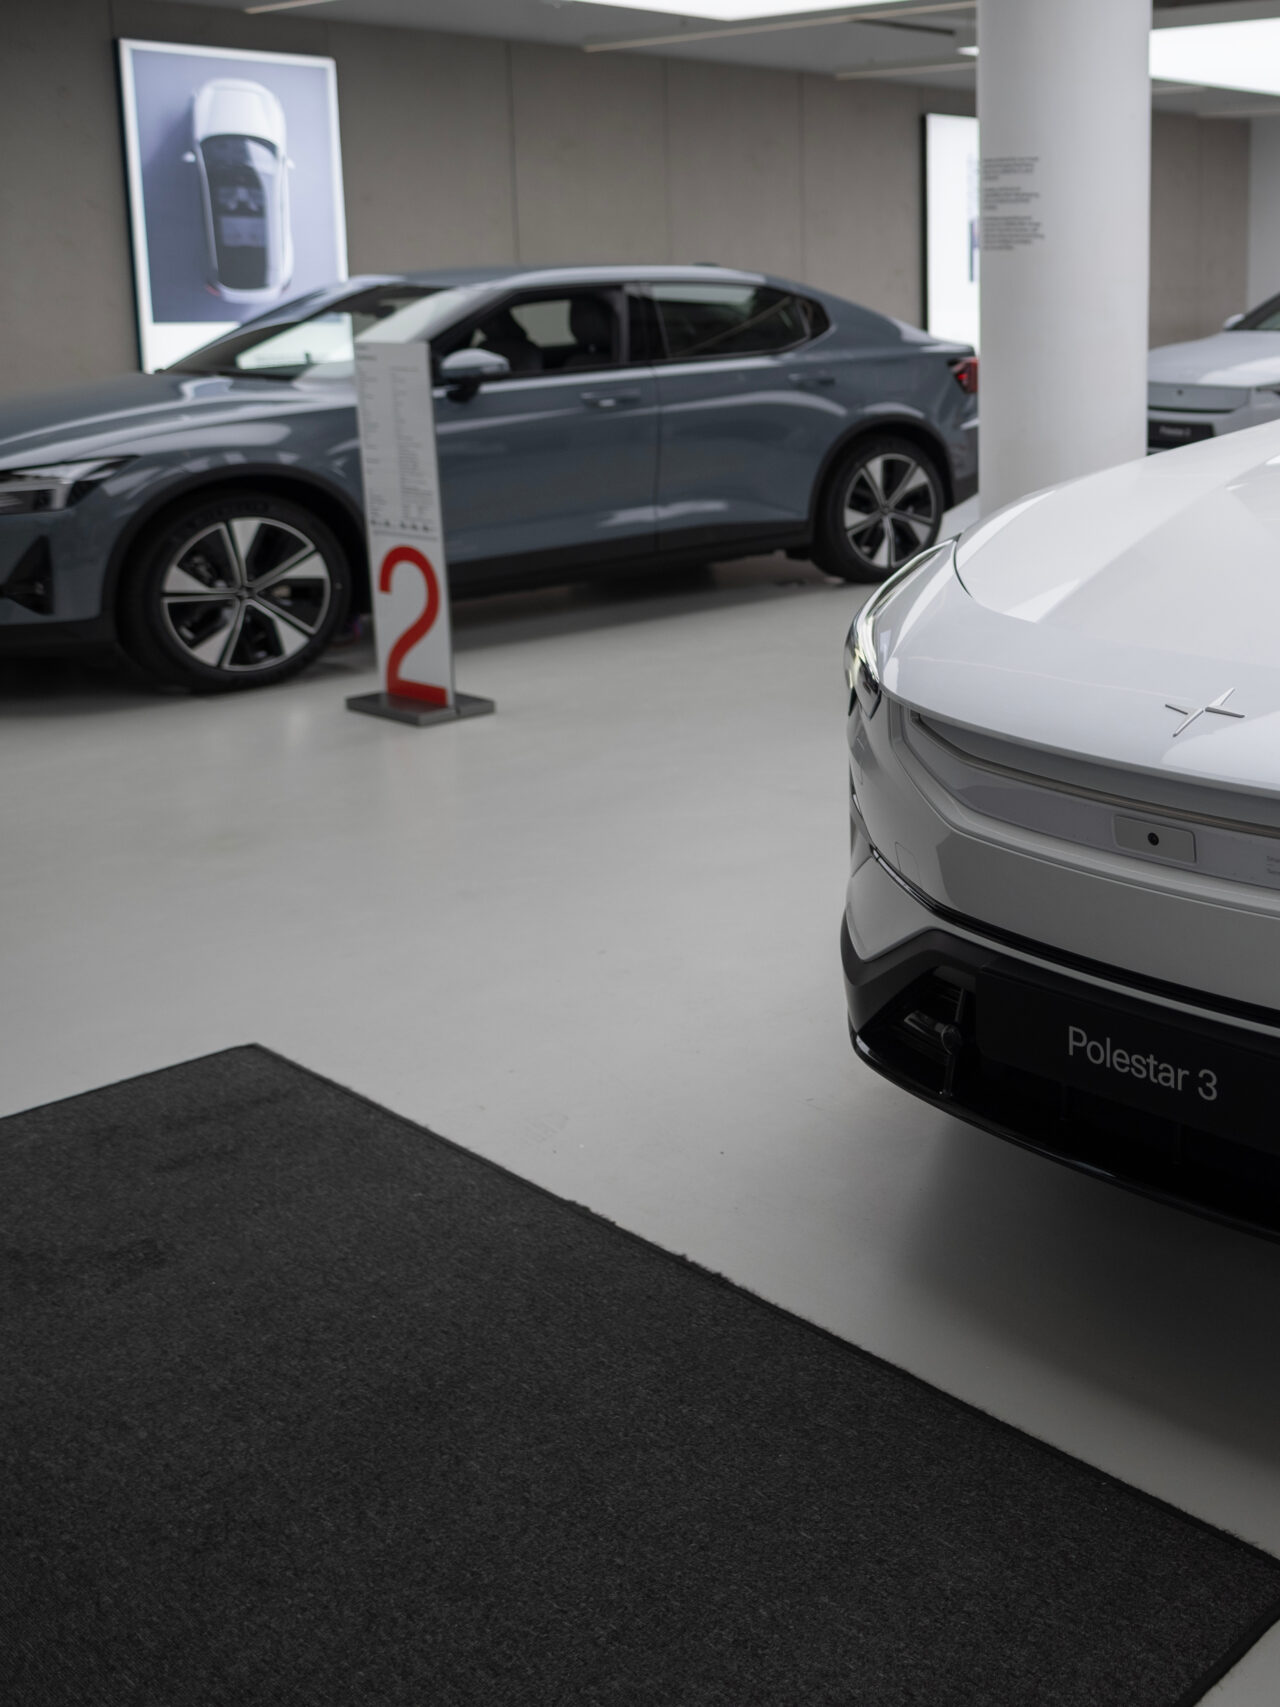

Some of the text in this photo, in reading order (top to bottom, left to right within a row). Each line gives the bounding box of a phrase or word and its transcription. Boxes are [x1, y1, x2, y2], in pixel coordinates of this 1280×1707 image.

[379, 545, 447, 706] 2
[1068, 1025, 1219, 1101] Polestar 3
